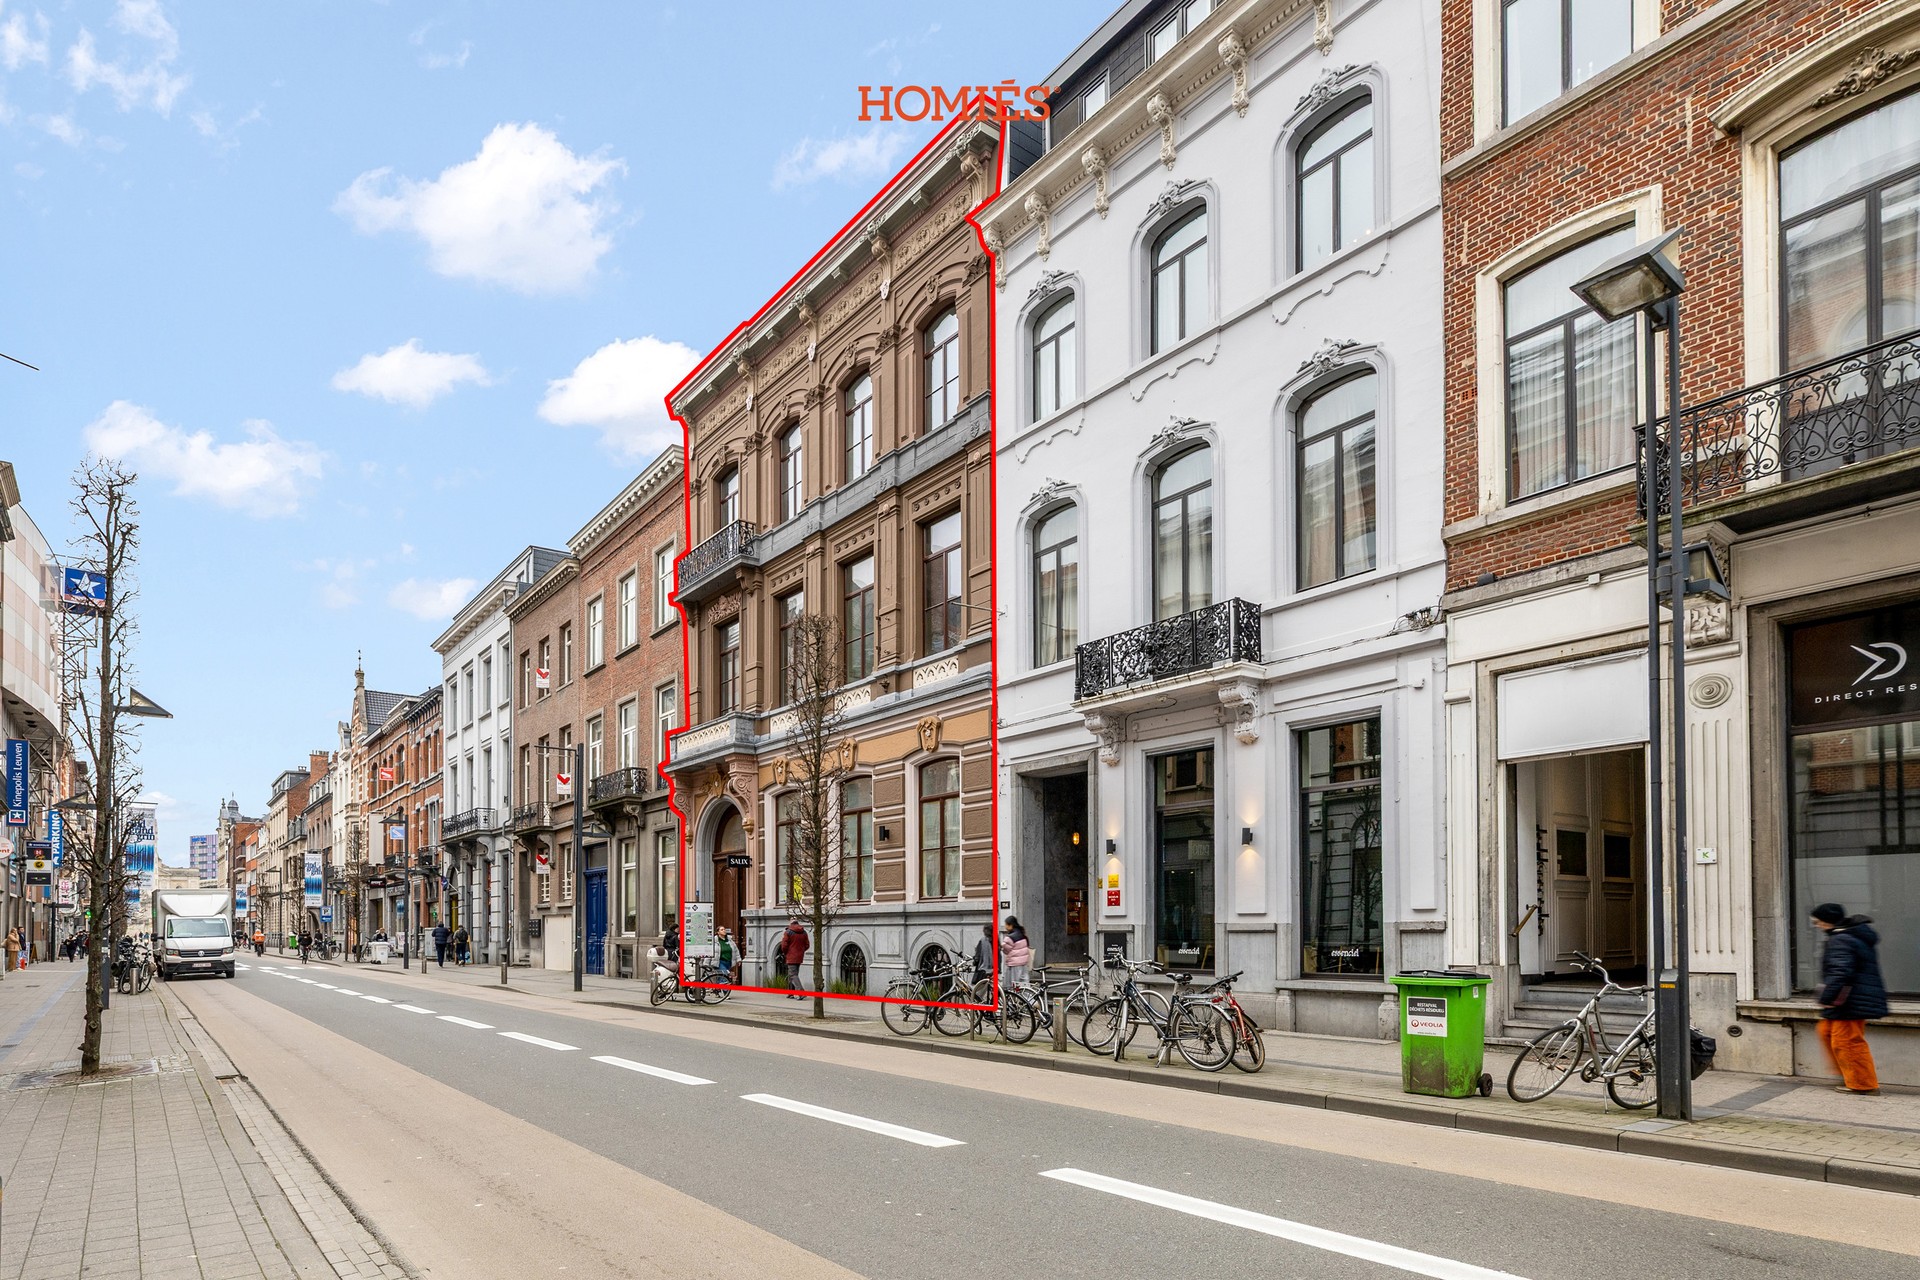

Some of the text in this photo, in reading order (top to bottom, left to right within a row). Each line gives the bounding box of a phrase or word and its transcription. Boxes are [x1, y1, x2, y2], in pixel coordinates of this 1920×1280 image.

[1814, 683, 1918, 704] DIRECT RES
[12, 742, 25, 807] Kinepolis Leuven
[51, 813, 61, 855] PARKING
[730, 857, 749, 865] SALIX
